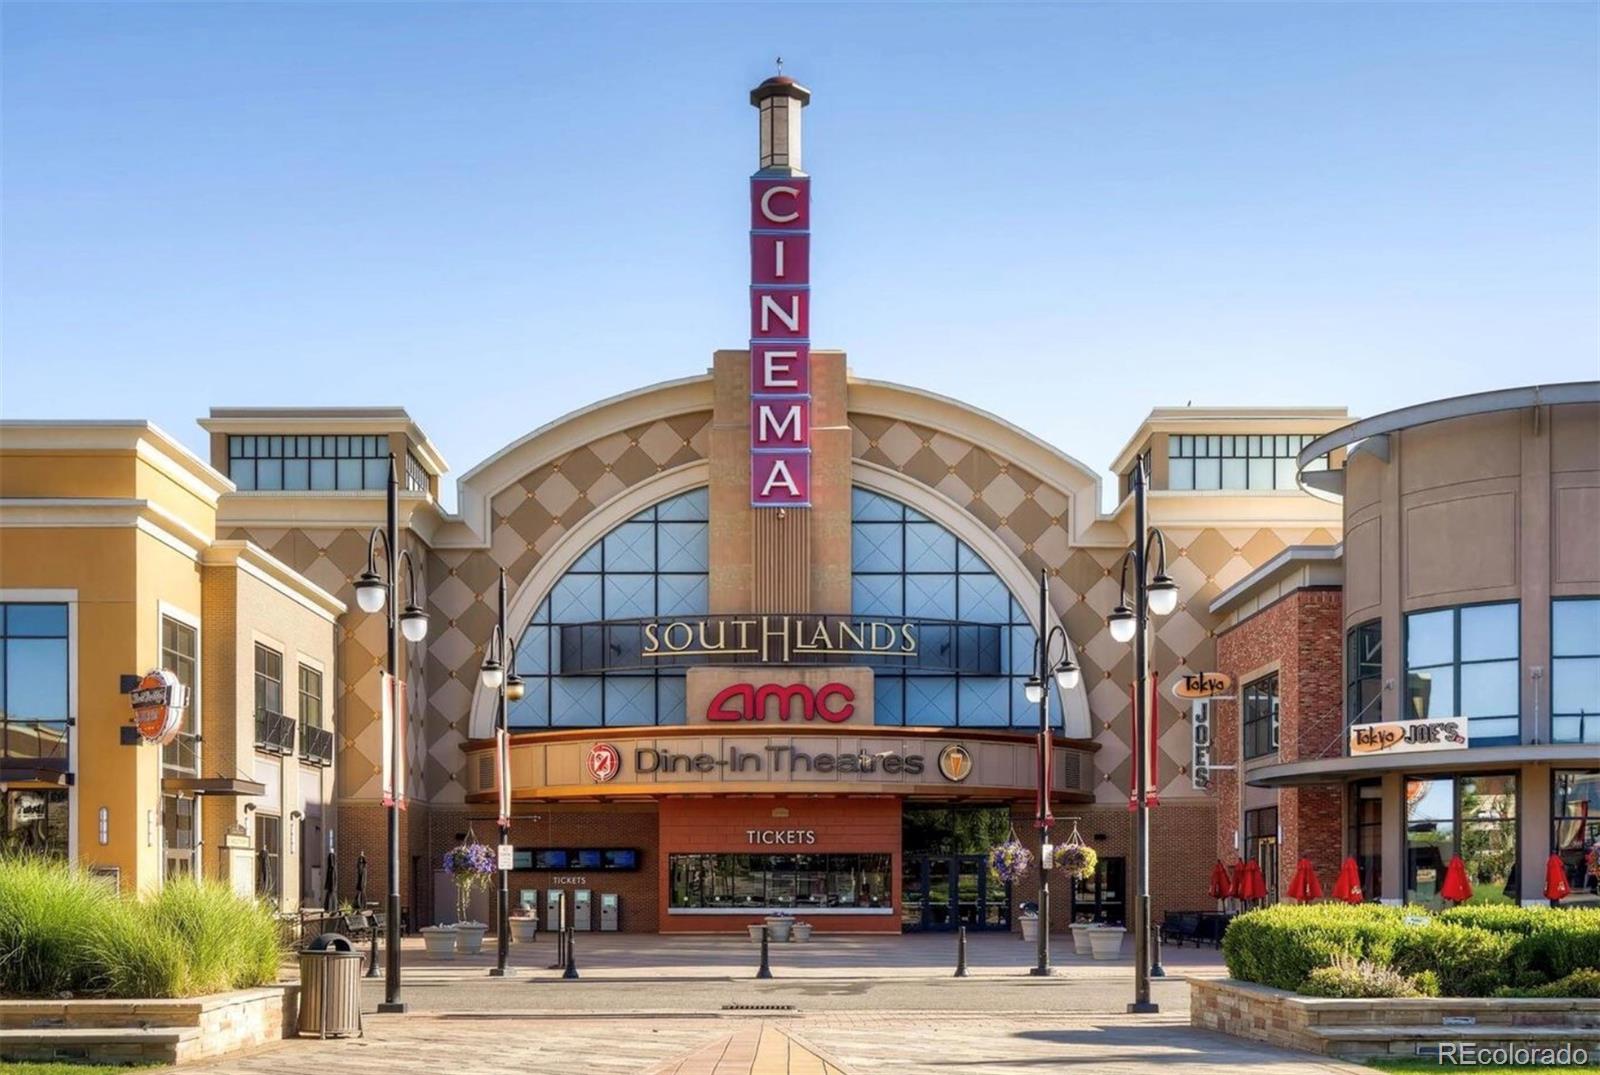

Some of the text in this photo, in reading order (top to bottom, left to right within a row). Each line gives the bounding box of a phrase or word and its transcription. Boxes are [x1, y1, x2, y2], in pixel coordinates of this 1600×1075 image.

[760, 185, 801, 496] CINEMA
[644, 616, 917, 662] SOUTHLANDS
[1182, 671, 1224, 697] Tokyo
[1353, 721, 1459, 750] Tokyo JOE'S
[634, 745, 926, 775] Dine-In Theatres
[746, 830, 815, 844] TICKETS
[553, 876, 587, 885] TICKETS
